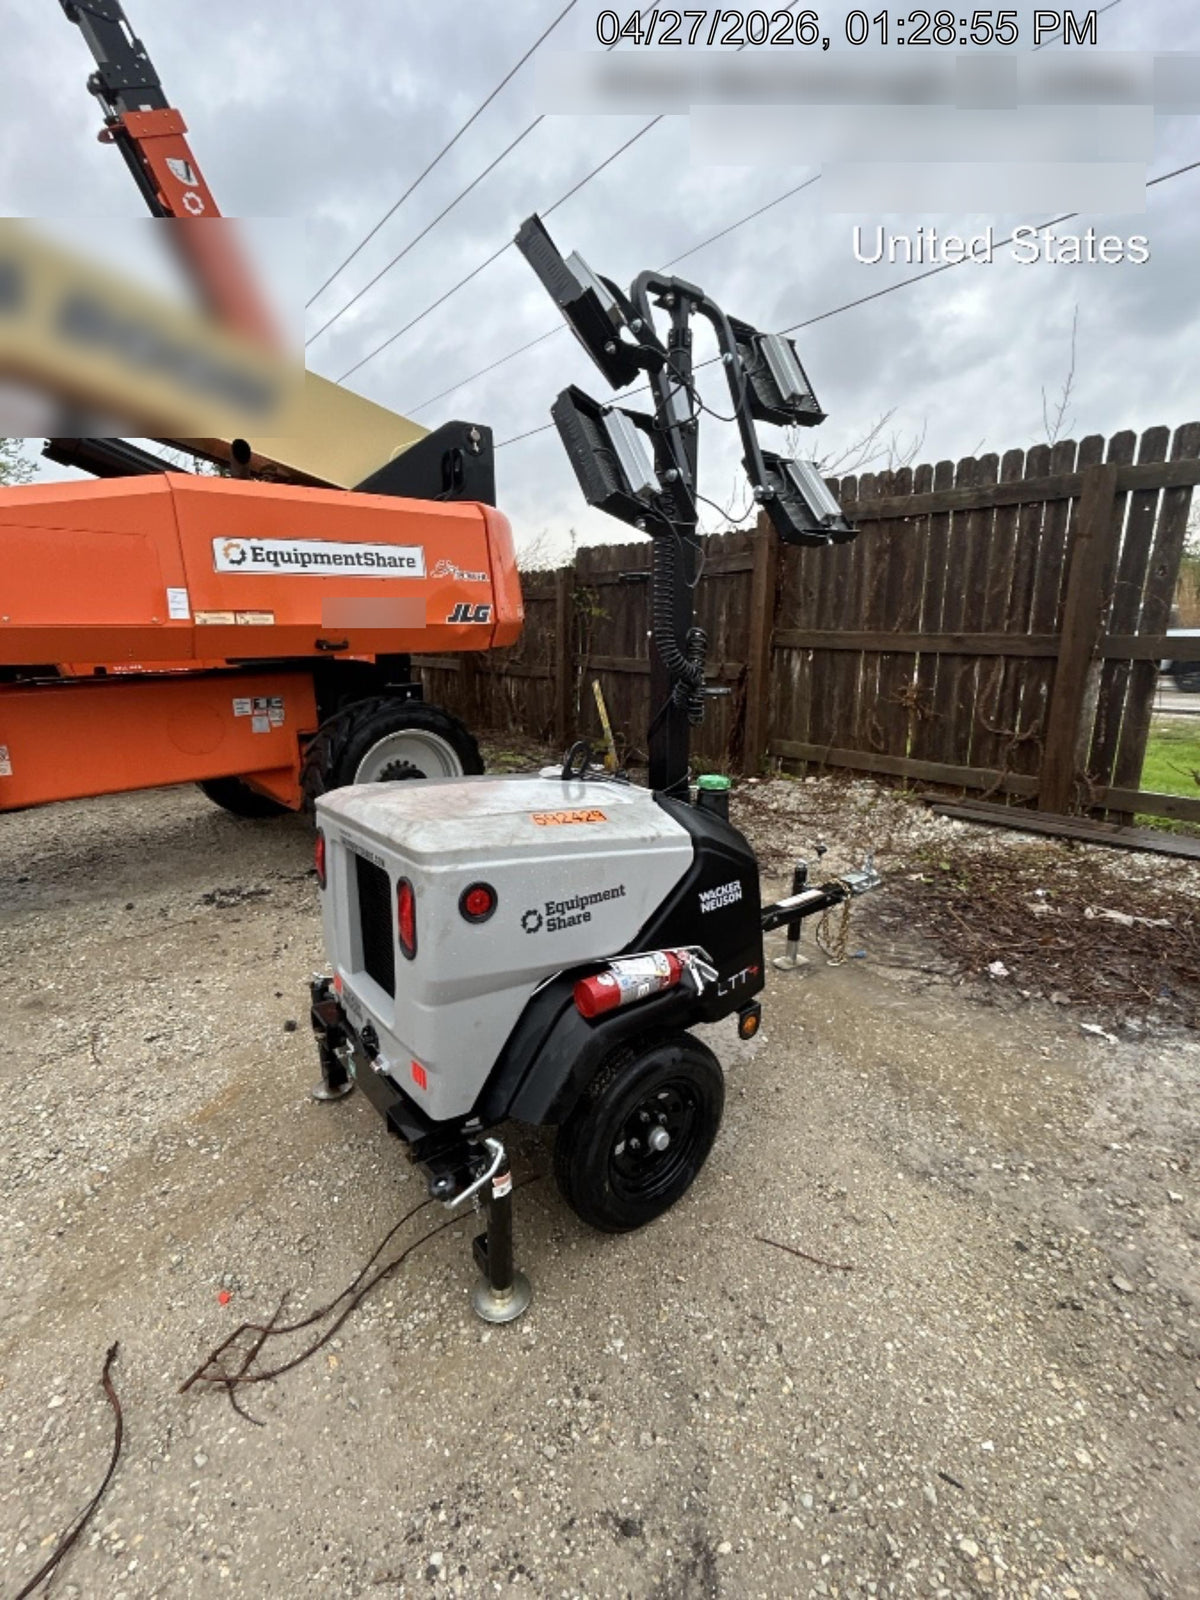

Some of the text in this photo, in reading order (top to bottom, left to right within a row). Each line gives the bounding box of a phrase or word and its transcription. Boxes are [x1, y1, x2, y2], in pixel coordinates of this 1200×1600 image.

[251, 545, 416, 568] EquipmentShare
[447, 603, 491, 623] JLG
[545, 884, 626, 916] Equipment
[699, 880, 741, 902] WACKER
[701, 890, 742, 914] NEUSON
[546, 911, 592, 932] Share
